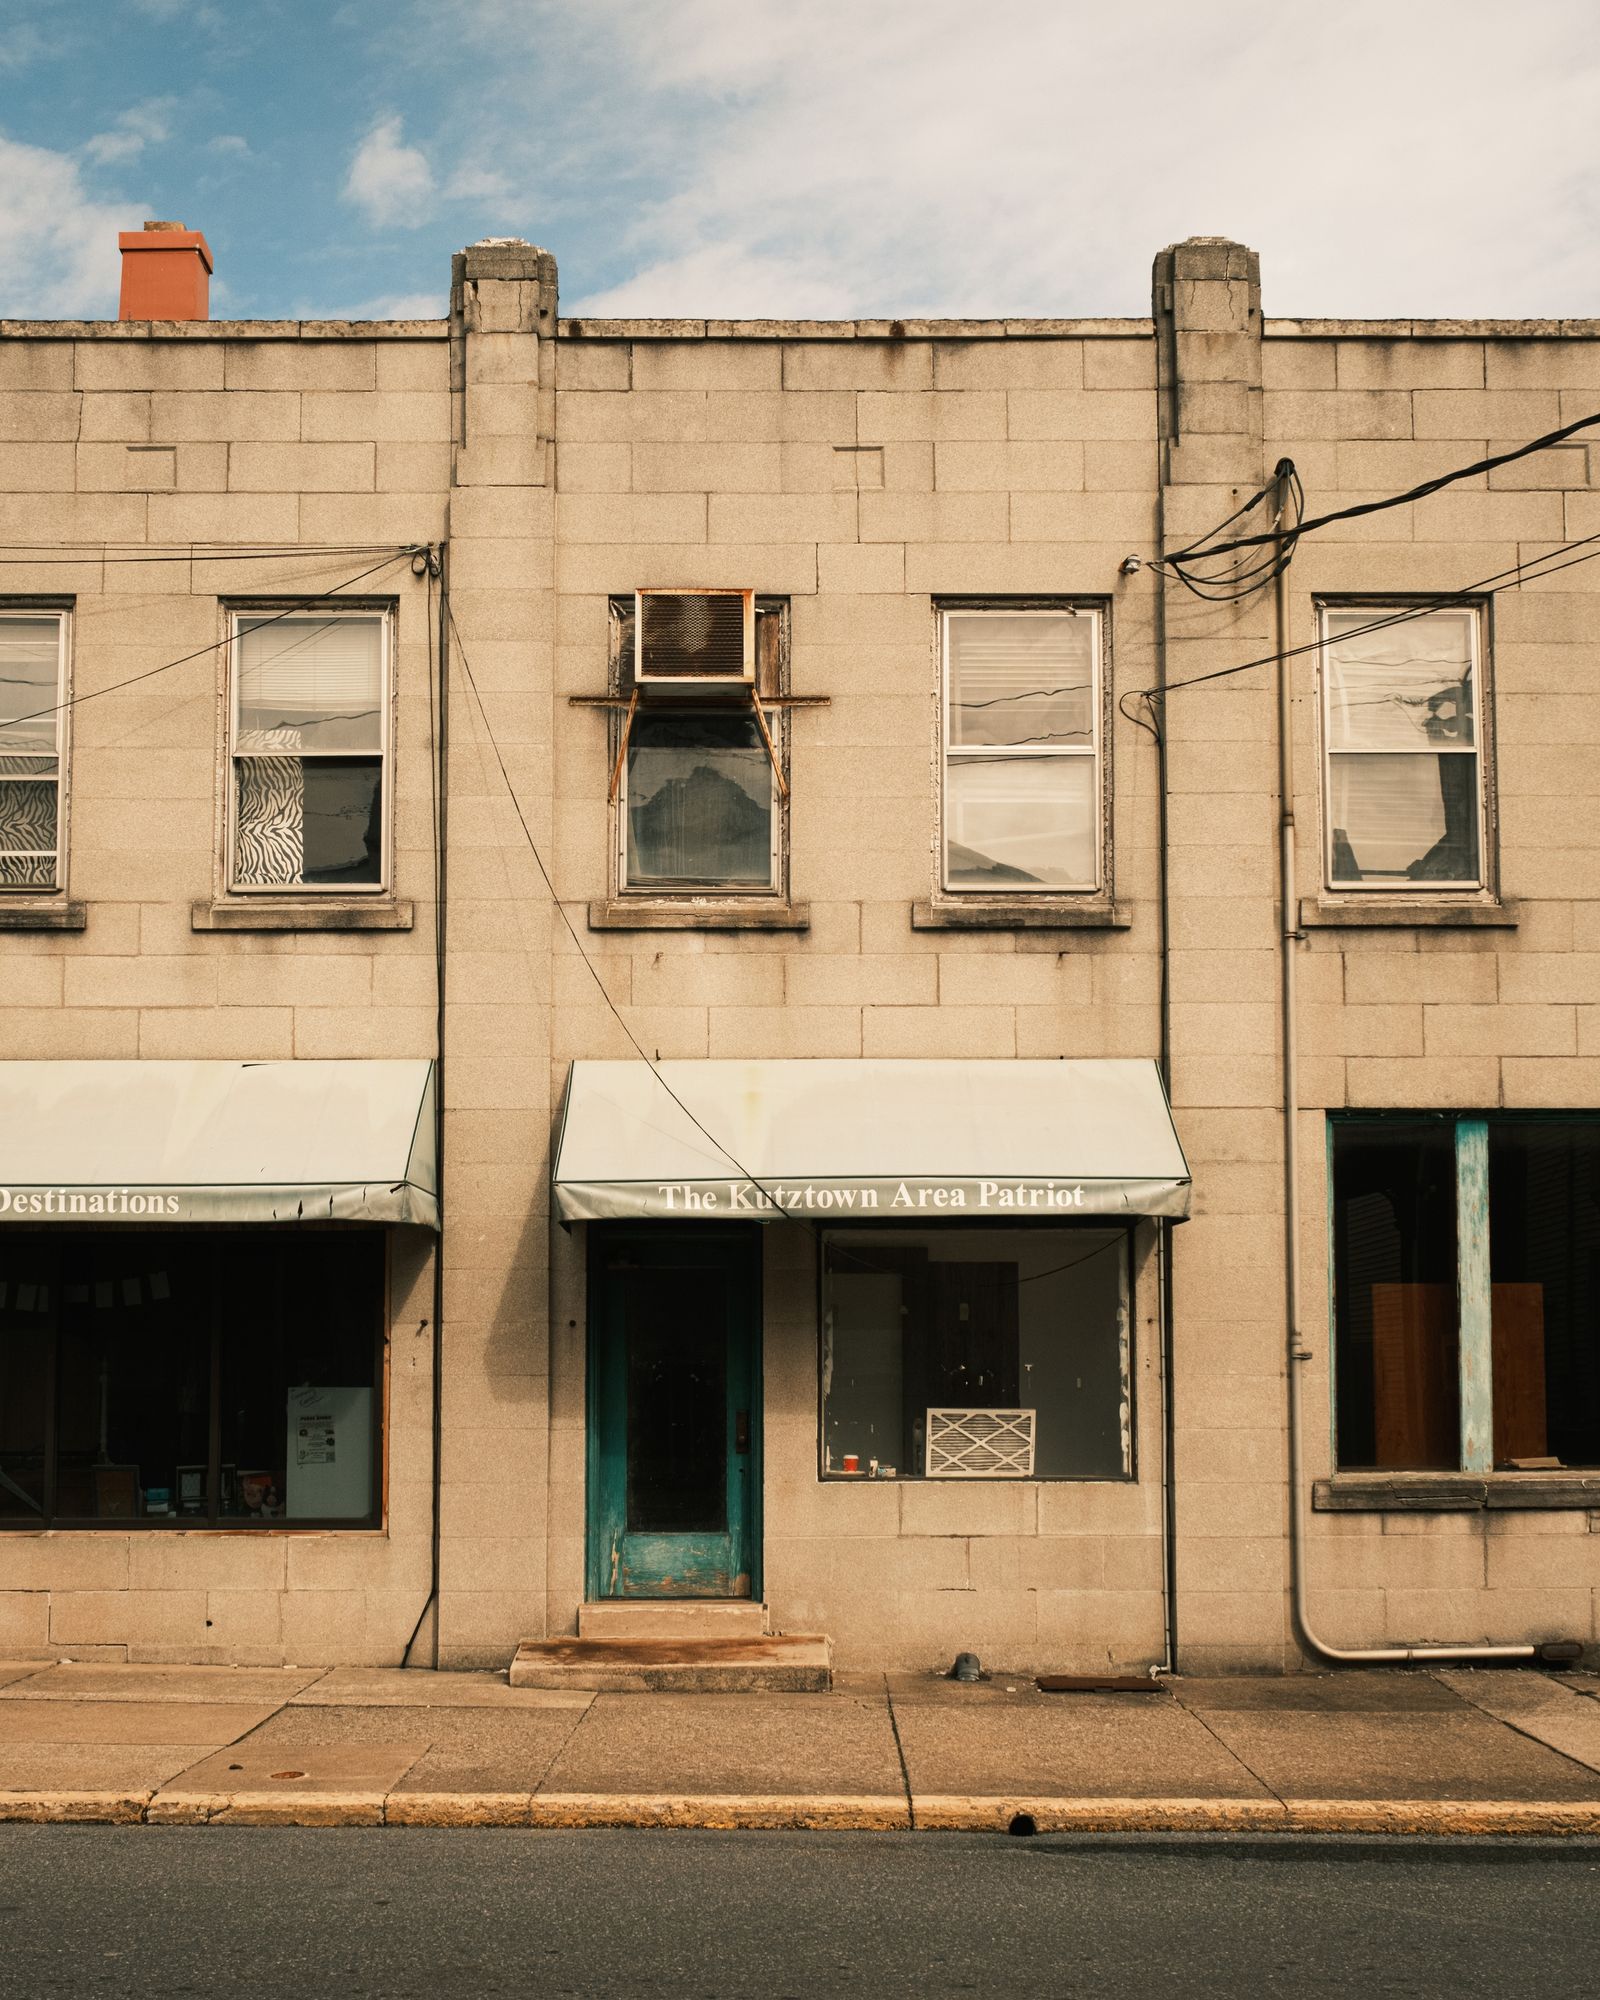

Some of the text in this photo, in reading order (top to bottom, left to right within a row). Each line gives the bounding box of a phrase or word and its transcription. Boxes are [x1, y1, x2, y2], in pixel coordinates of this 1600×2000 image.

[658, 1181, 1085, 1210] The Kutztown Area Patriot
